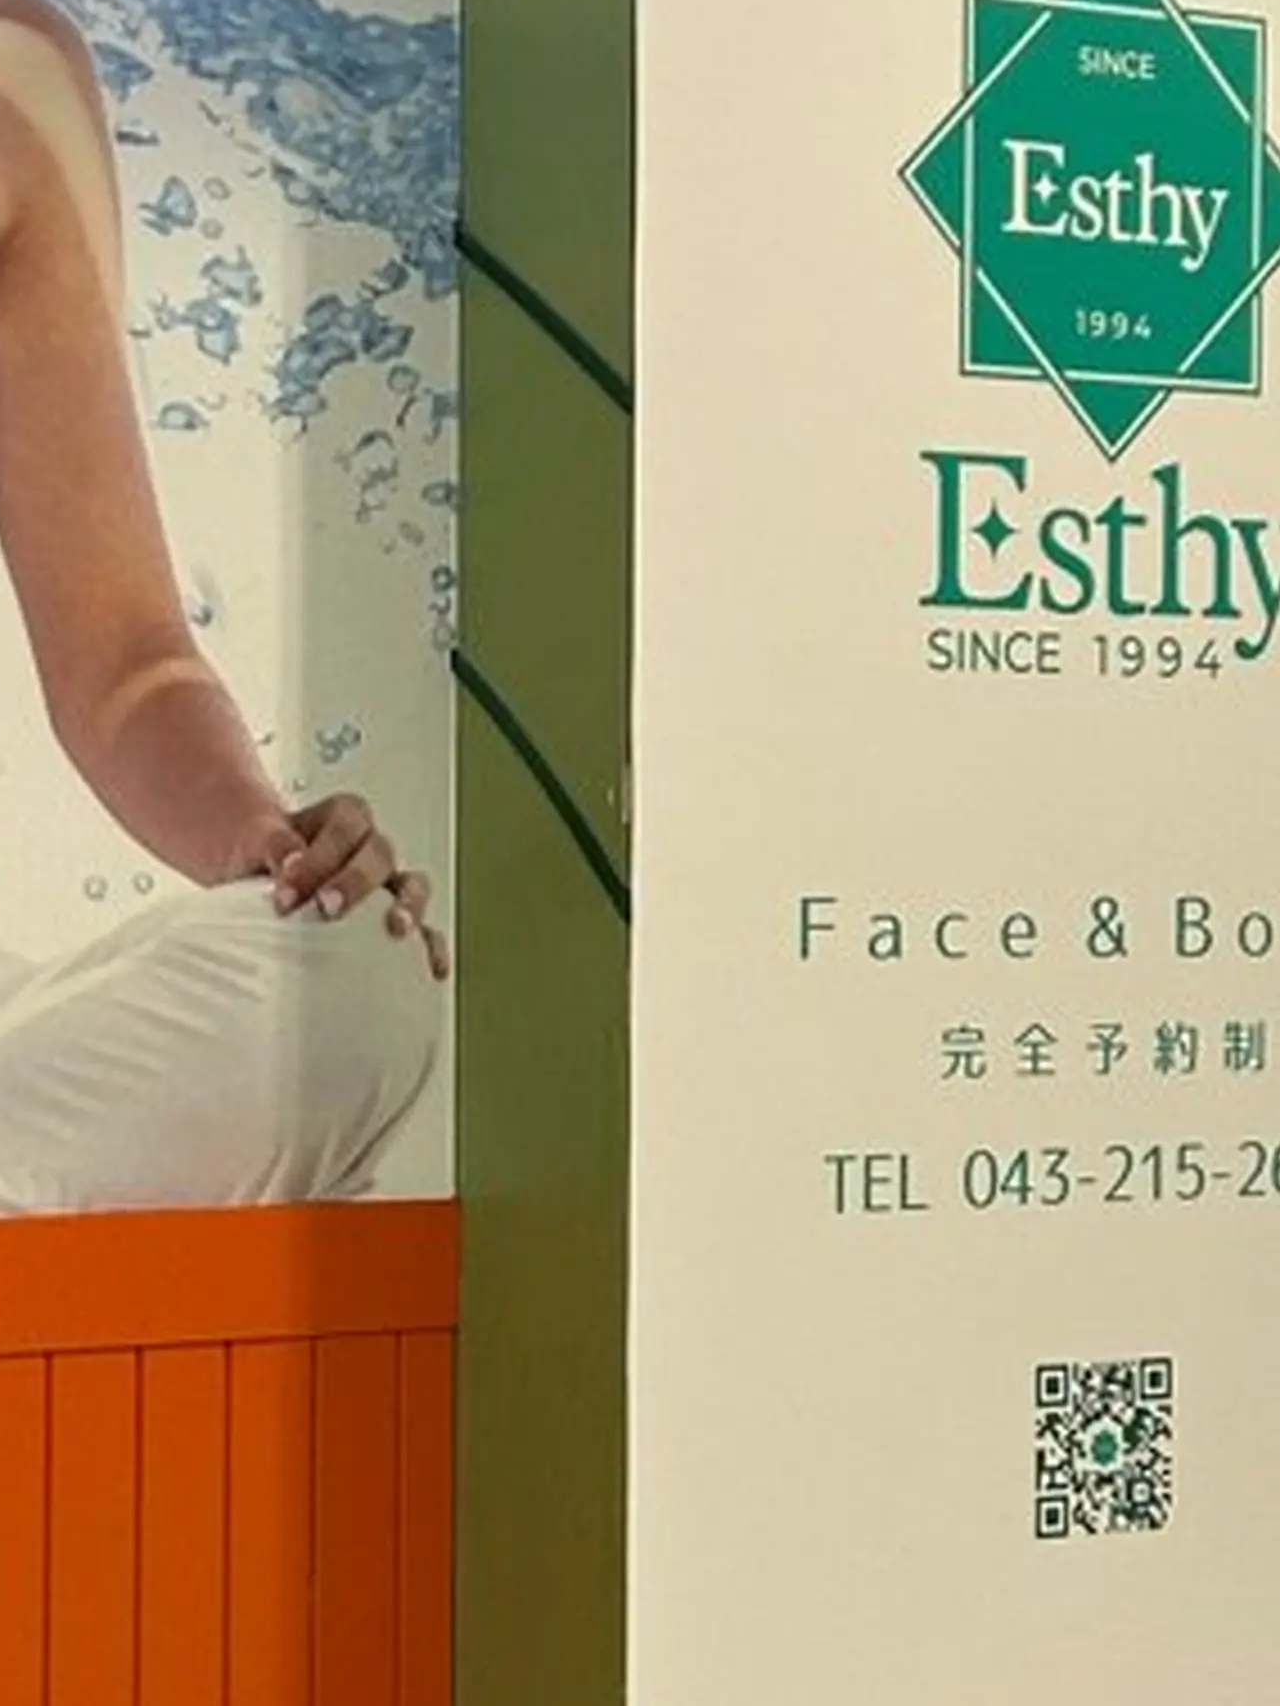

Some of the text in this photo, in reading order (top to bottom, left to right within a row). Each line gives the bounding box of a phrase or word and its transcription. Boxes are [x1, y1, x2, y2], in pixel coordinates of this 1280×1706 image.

[1078, 45, 1155, 80] SINCE
[1001, 139, 1230, 272] Esthy
[1075, 310, 1151, 339] 1994
[927, 630, 1222, 677] SINCE 1994
[799, 896, 1038, 960] Face
[1087, 896, 1128, 957] &
[940, 1020, 1268, 1080] 完全予約制
[825, 1154, 928, 1213] TEL
